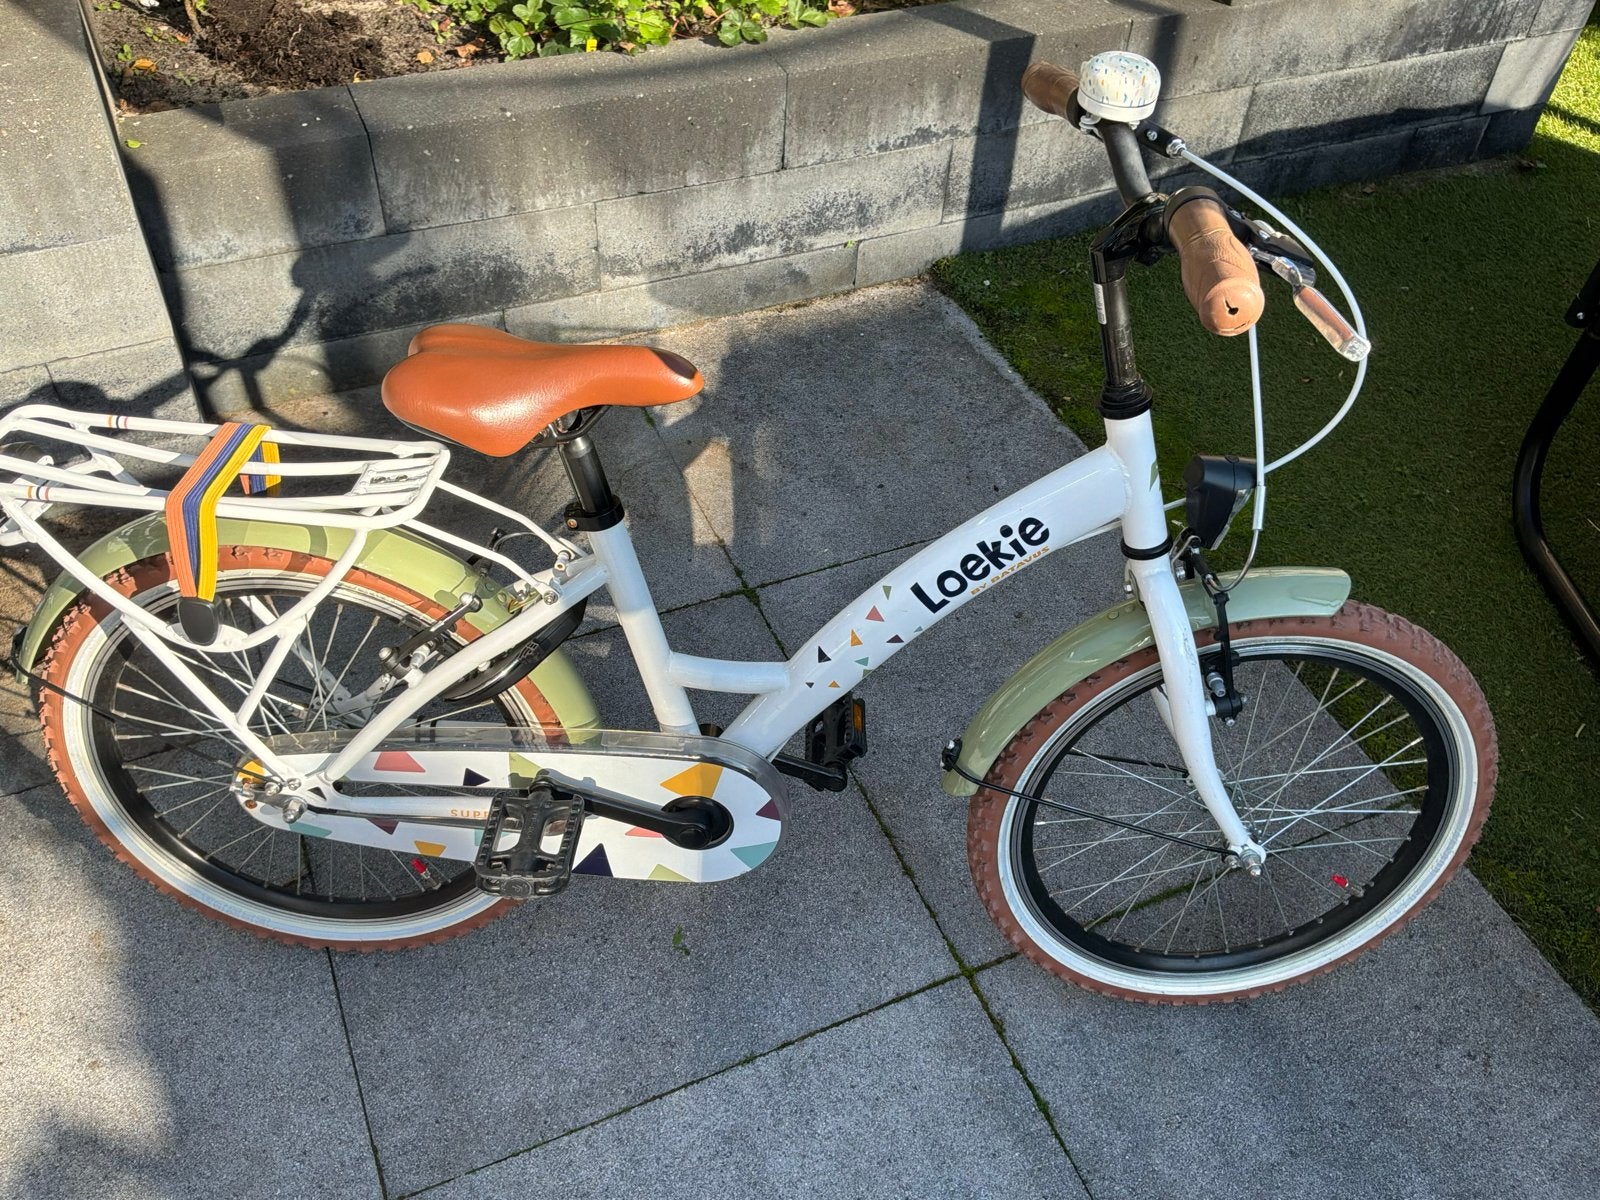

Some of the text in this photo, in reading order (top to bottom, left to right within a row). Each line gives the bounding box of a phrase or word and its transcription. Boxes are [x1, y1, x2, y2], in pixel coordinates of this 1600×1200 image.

[910, 517, 1050, 614] Loekie
[970, 546, 1050, 595] BY BATAVUS
